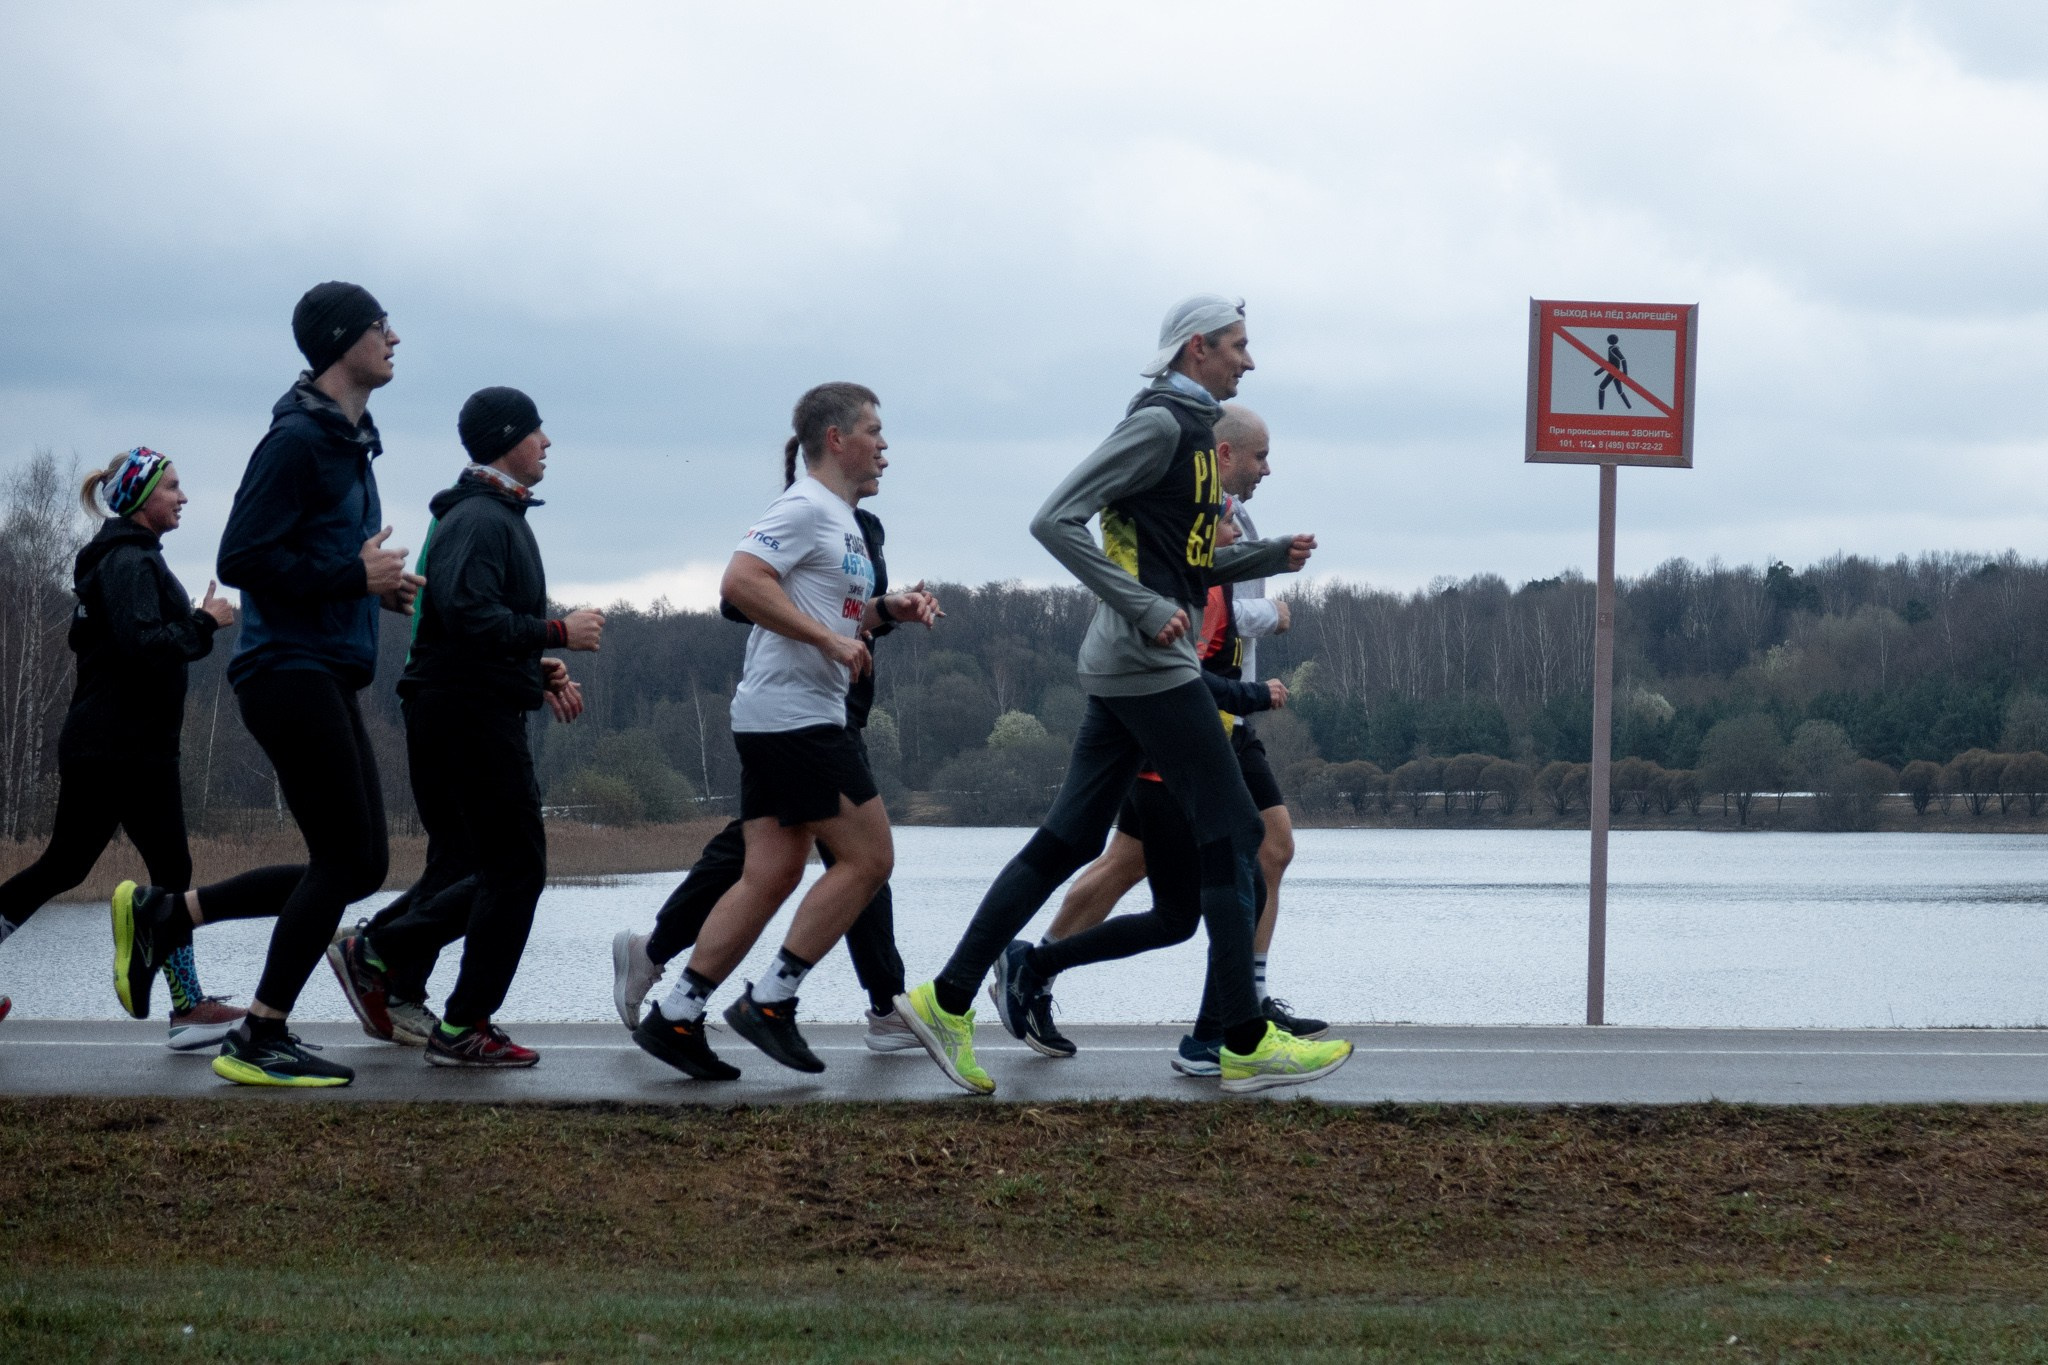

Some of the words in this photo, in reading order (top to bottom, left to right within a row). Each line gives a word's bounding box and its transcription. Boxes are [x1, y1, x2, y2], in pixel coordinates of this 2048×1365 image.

[1553, 308, 1588, 318] ВЫХОД
[1590, 310, 1603, 318] НА
[1605, 309, 1624, 320] ЛЁД
[1625, 311, 1678, 321] ЗАПРЕЩЁН
[1549, 426, 1565, 435] При
[1567, 428, 1630, 437] происшествиях
[1631, 429, 1674, 438] ЗВОНИТЬ:
[1559, 440, 1575, 448] 101,
[1598, 440, 1604, 448] 8
[1605, 441, 1625, 450] (495)
[1626, 441, 1663, 450] 637-22-22
[753, 531, 781, 550] ПСБ
